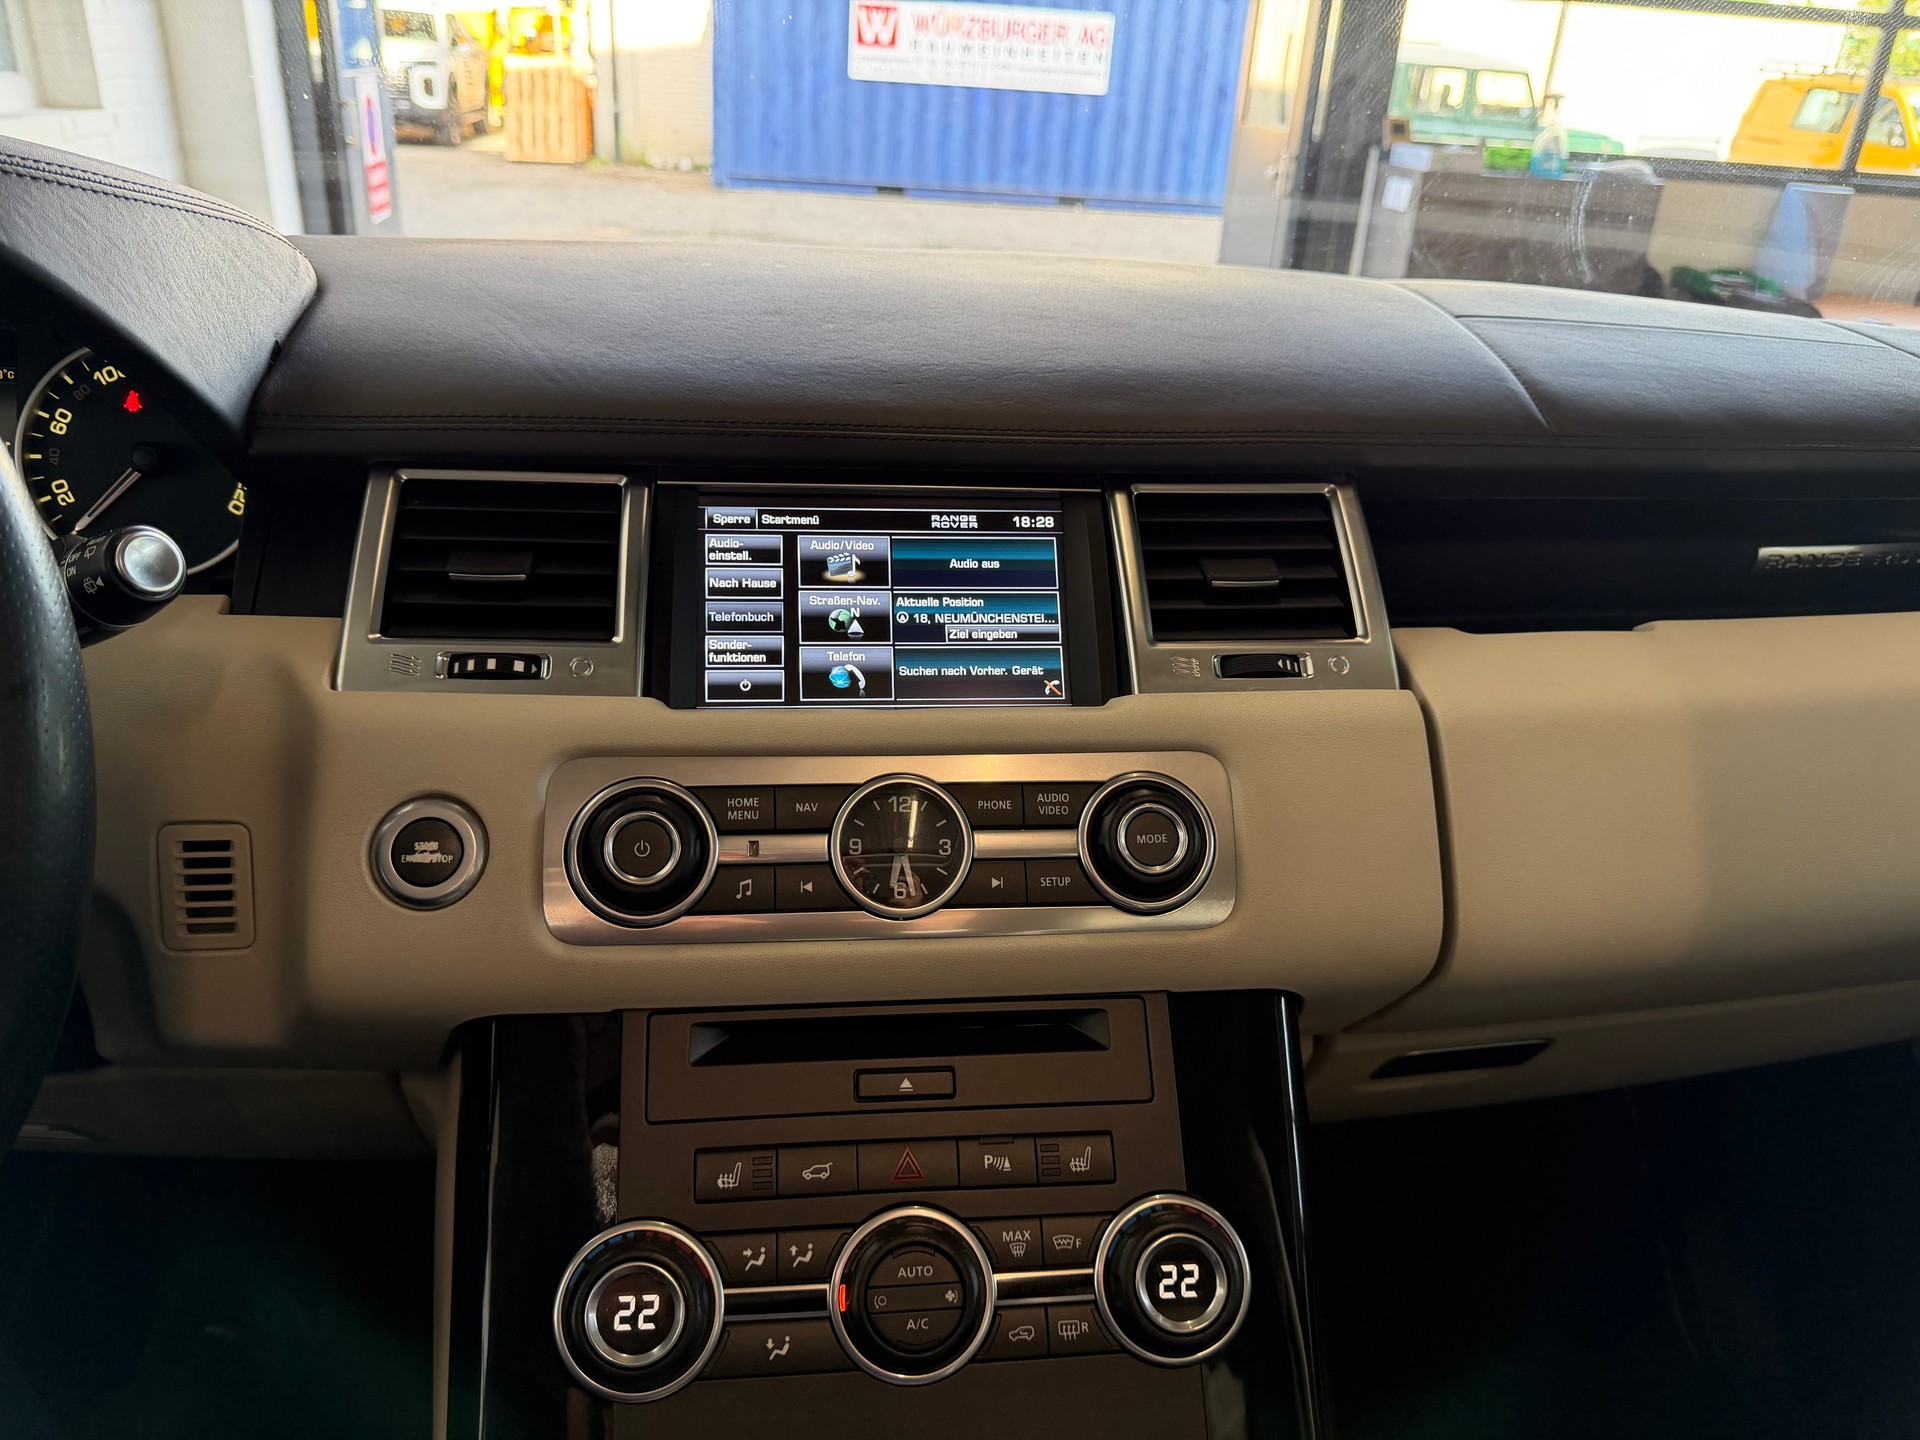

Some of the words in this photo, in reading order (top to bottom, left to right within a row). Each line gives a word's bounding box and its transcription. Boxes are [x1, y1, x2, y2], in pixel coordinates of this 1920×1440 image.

[49, 408, 73, 436] 60
[51, 479, 76, 507] 20
[713, 513, 751, 526] Sperre
[761, 513, 820, 525] Startmenü
[931, 514, 978, 522] RANGE
[1012, 515, 1055, 529] 18:28
[931, 521, 979, 529] ROVER
[708, 537, 744, 549] Audio-
[810, 539, 875, 552] Audio/Video
[708, 550, 753, 562] einstell.
[949, 558, 978, 569] Audio
[981, 560, 1000, 569] aus
[709, 577, 740, 589] Nach
[743, 577, 777, 589] Hause
[809, 595, 881, 607] Straßen-Nav.
[896, 596, 940, 608] Aktuelle
[943, 596, 984, 608] Position
[709, 611, 774, 623] Telefonbuch
[913, 613, 931, 625] 18,
[949, 627, 968, 639] Ziel
[971, 628, 1018, 641] eingeben
[708, 639, 752, 651] Sonder-
[708, 652, 766, 664] funktionen
[827, 650, 866, 662] Telefon
[898, 664, 939, 677] Suchen
[942, 665, 967, 677] nach
[969, 665, 1008, 677] Vorher.
[1012, 664, 1044, 677] Gerät
[727, 797, 759, 808] HOME
[888, 795, 912, 813] 12
[1036, 792, 1070, 804] AUDIO
[795, 802, 818, 813] NAV
[977, 799, 1012, 811] PHONE
[1038, 804, 1069, 816] VIDEO
[727, 810, 759, 821] MENU
[1136, 833, 1168, 845] MODE
[848, 838, 863, 856] 9
[938, 838, 952, 856] 3
[1040, 876, 1071, 888] SETUP
[1002, 1230, 1031, 1243] MAX
[1075, 1238, 1082, 1249] F
[897, 1265, 934, 1279] AUTO
[1158, 1264, 1200, 1299] 22
[614, 1294, 660, 1331] 22
[906, 1318, 930, 1331] A/C
[1081, 1322, 1089, 1333] R
